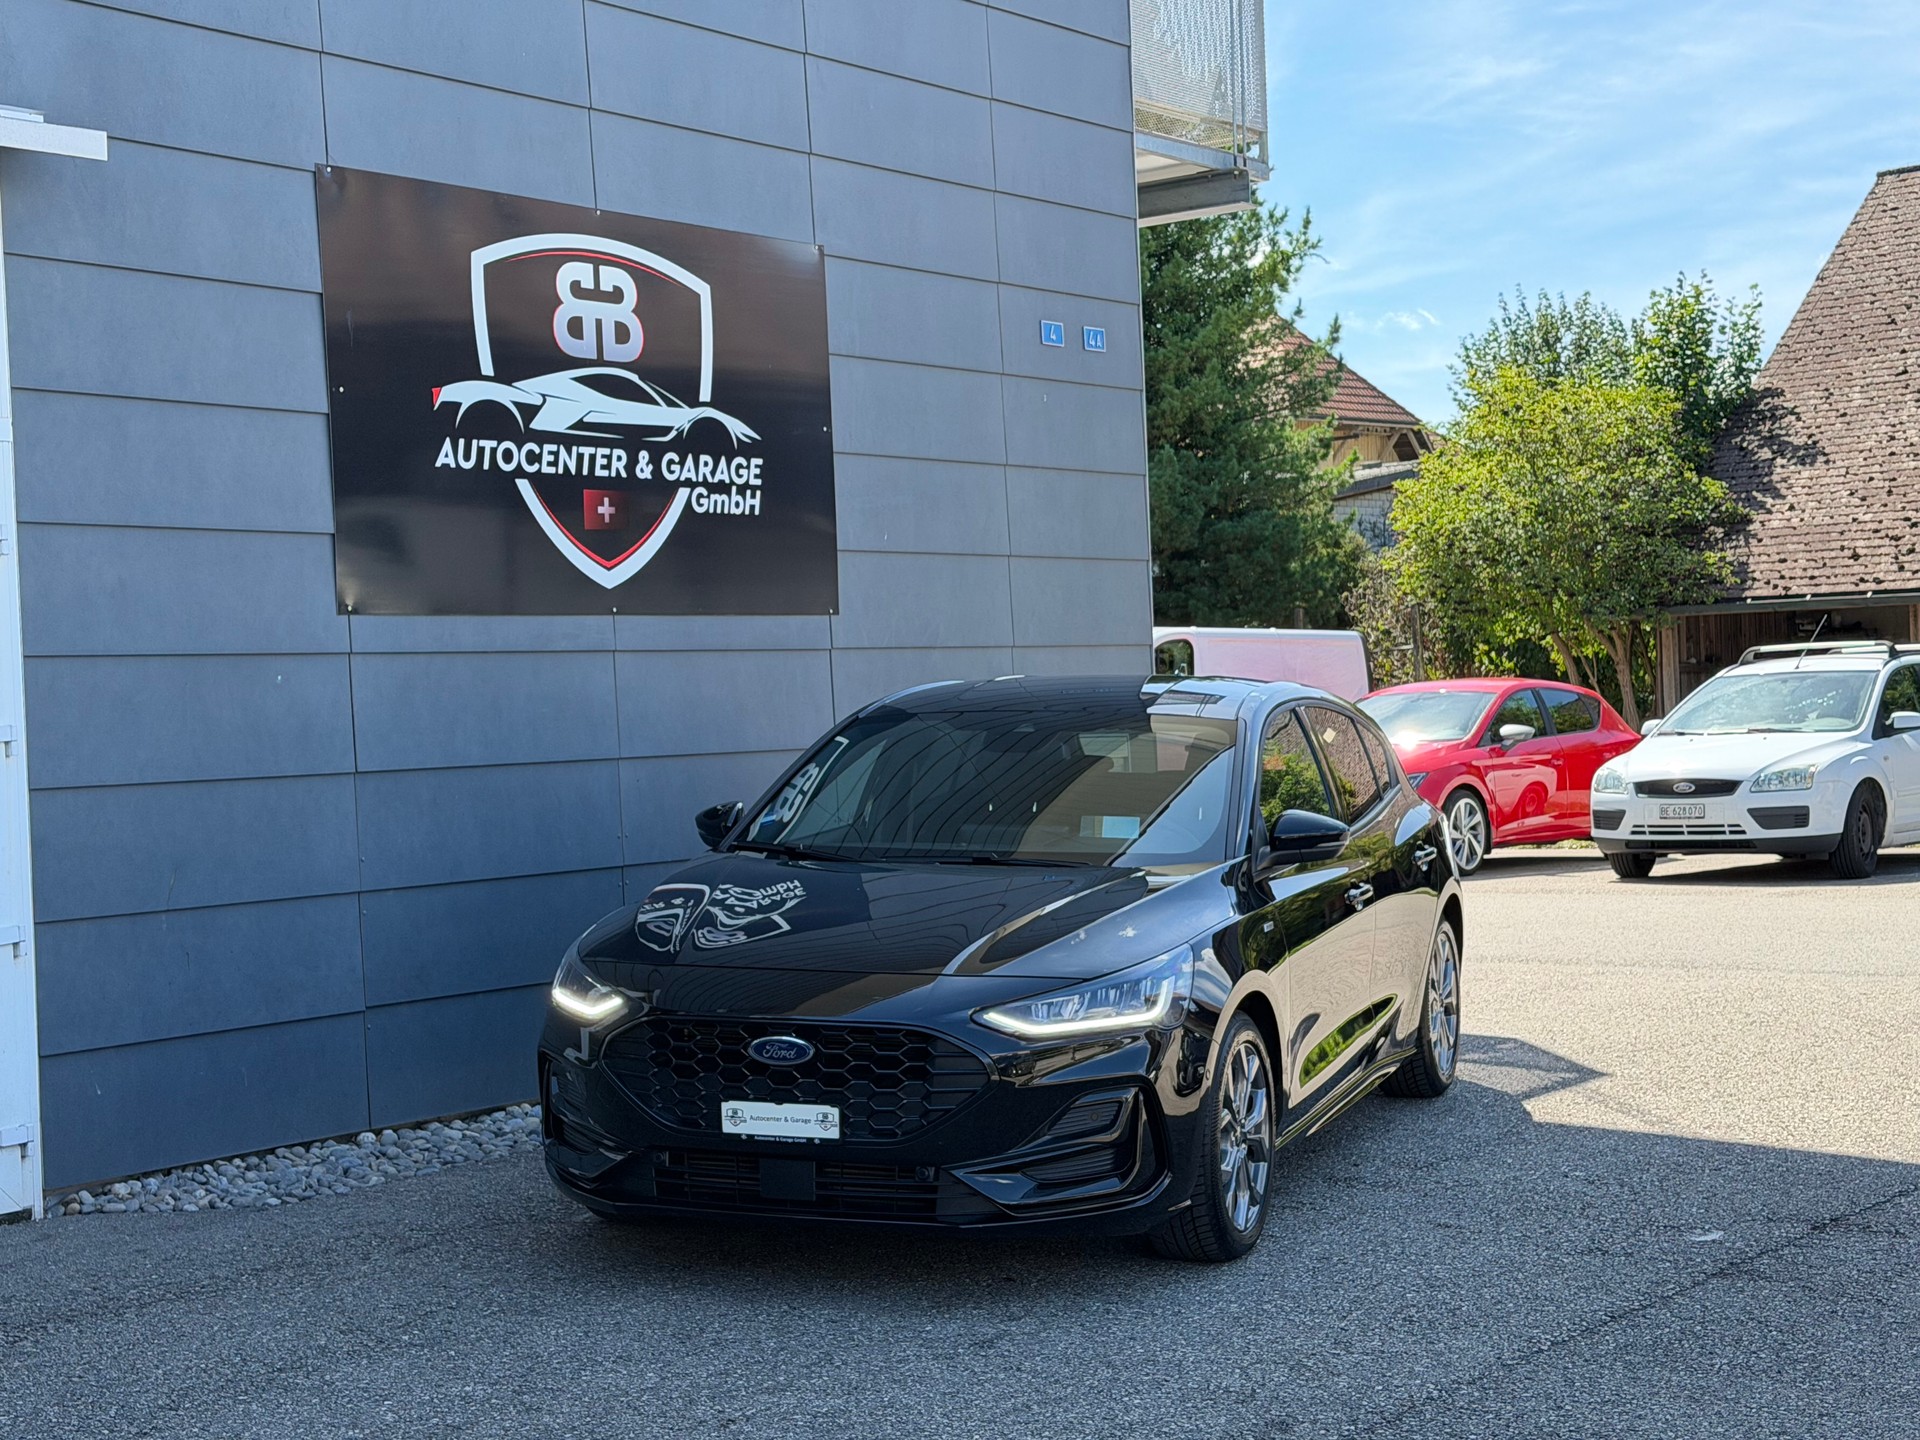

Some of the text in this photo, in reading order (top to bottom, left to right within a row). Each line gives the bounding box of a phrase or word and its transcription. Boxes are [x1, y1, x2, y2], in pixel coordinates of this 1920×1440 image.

[1050, 325, 1057, 342] 4
[435, 437, 763, 486] AUTOCENTER & GARAGE
[691, 486, 761, 516] GmbH
[1661, 806, 1670, 816] BE
[762, 1042, 797, 1059] Ford
[749, 1114, 782, 1123] Autocenter
[790, 1116, 812, 1124] Garage
